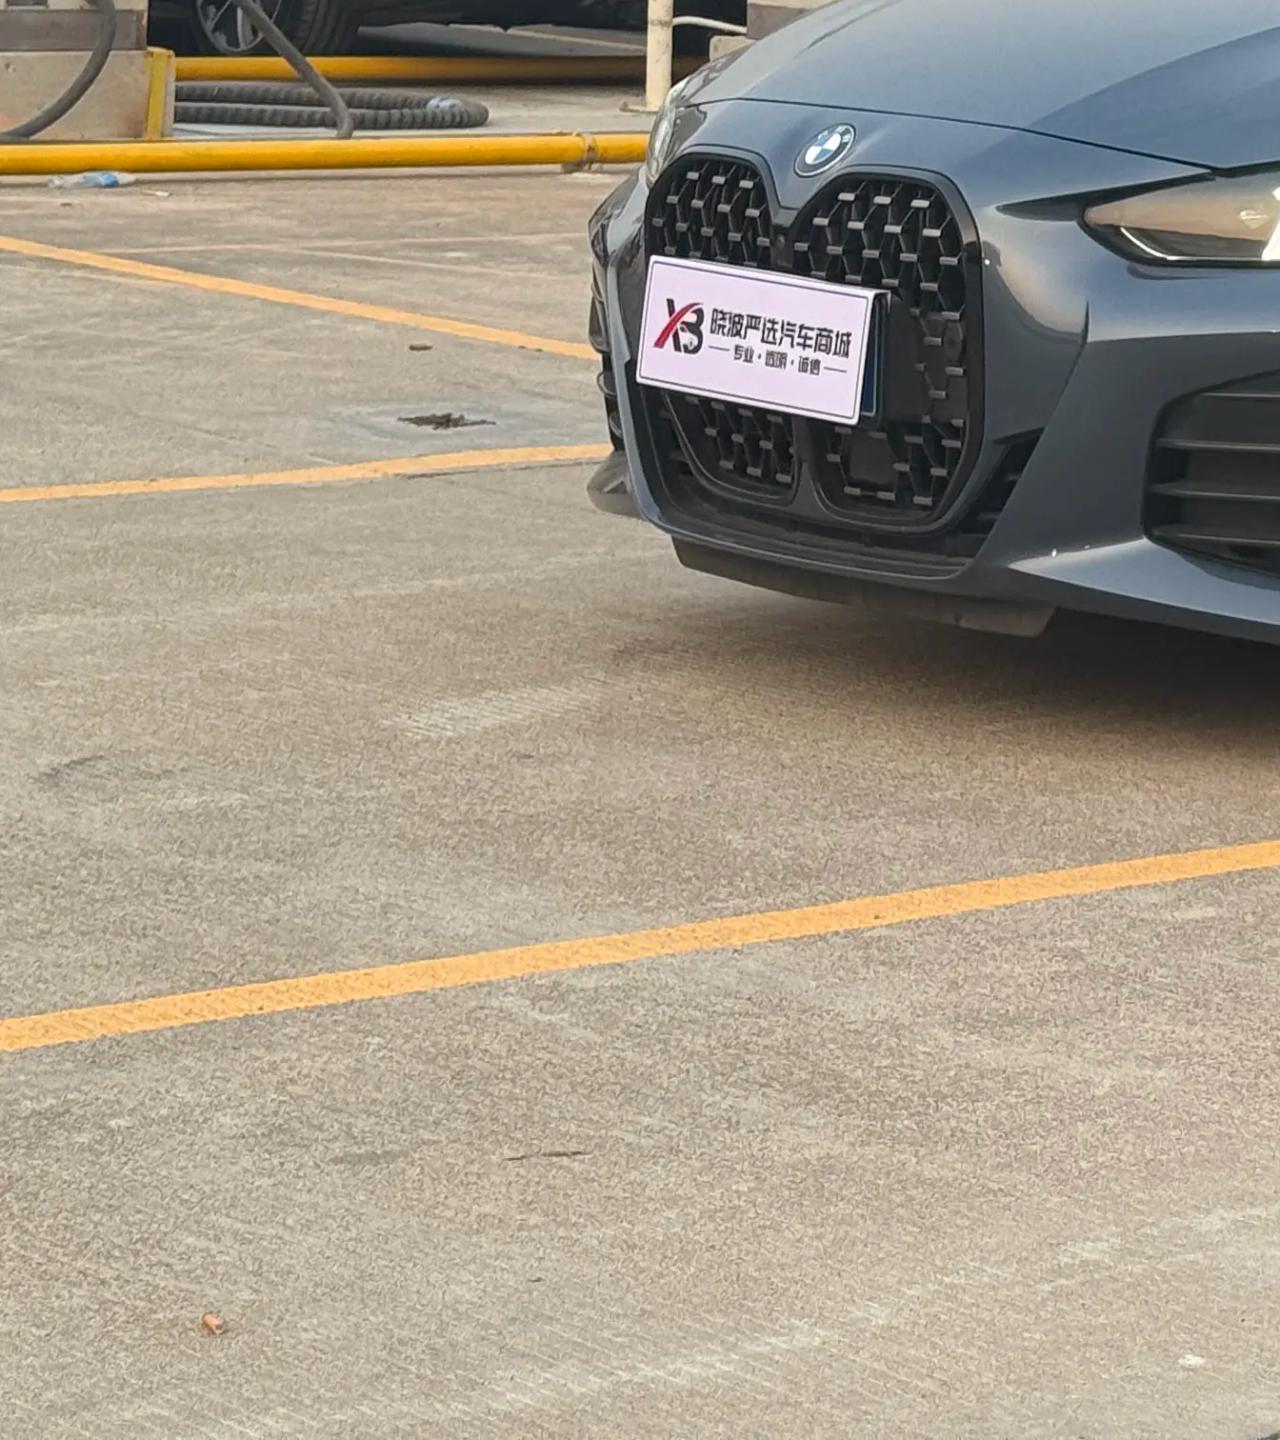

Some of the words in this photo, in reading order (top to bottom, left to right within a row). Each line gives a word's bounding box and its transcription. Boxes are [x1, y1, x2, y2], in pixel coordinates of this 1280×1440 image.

[709, 307, 852, 359] 晓波严选汽车商城
